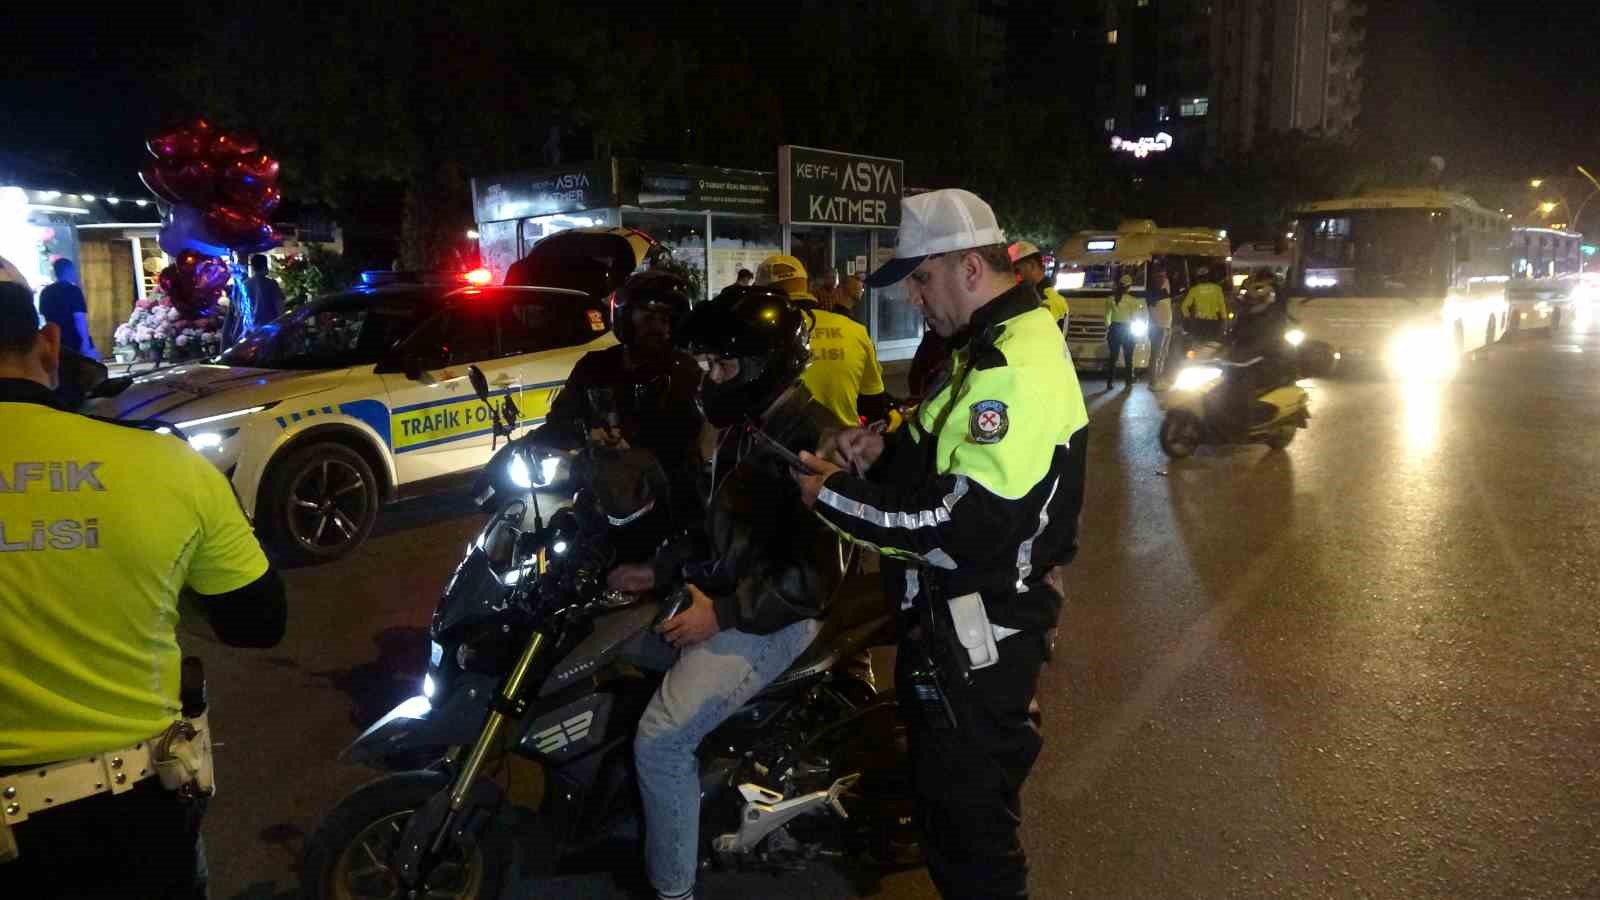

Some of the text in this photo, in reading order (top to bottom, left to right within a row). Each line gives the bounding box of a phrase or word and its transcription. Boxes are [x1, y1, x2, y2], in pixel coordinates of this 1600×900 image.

[555, 172, 590, 189] ASYA
[841, 162, 897, 194] ASYA
[808, 194, 888, 224] KATMER
[401, 408, 461, 437] TRAFİK
